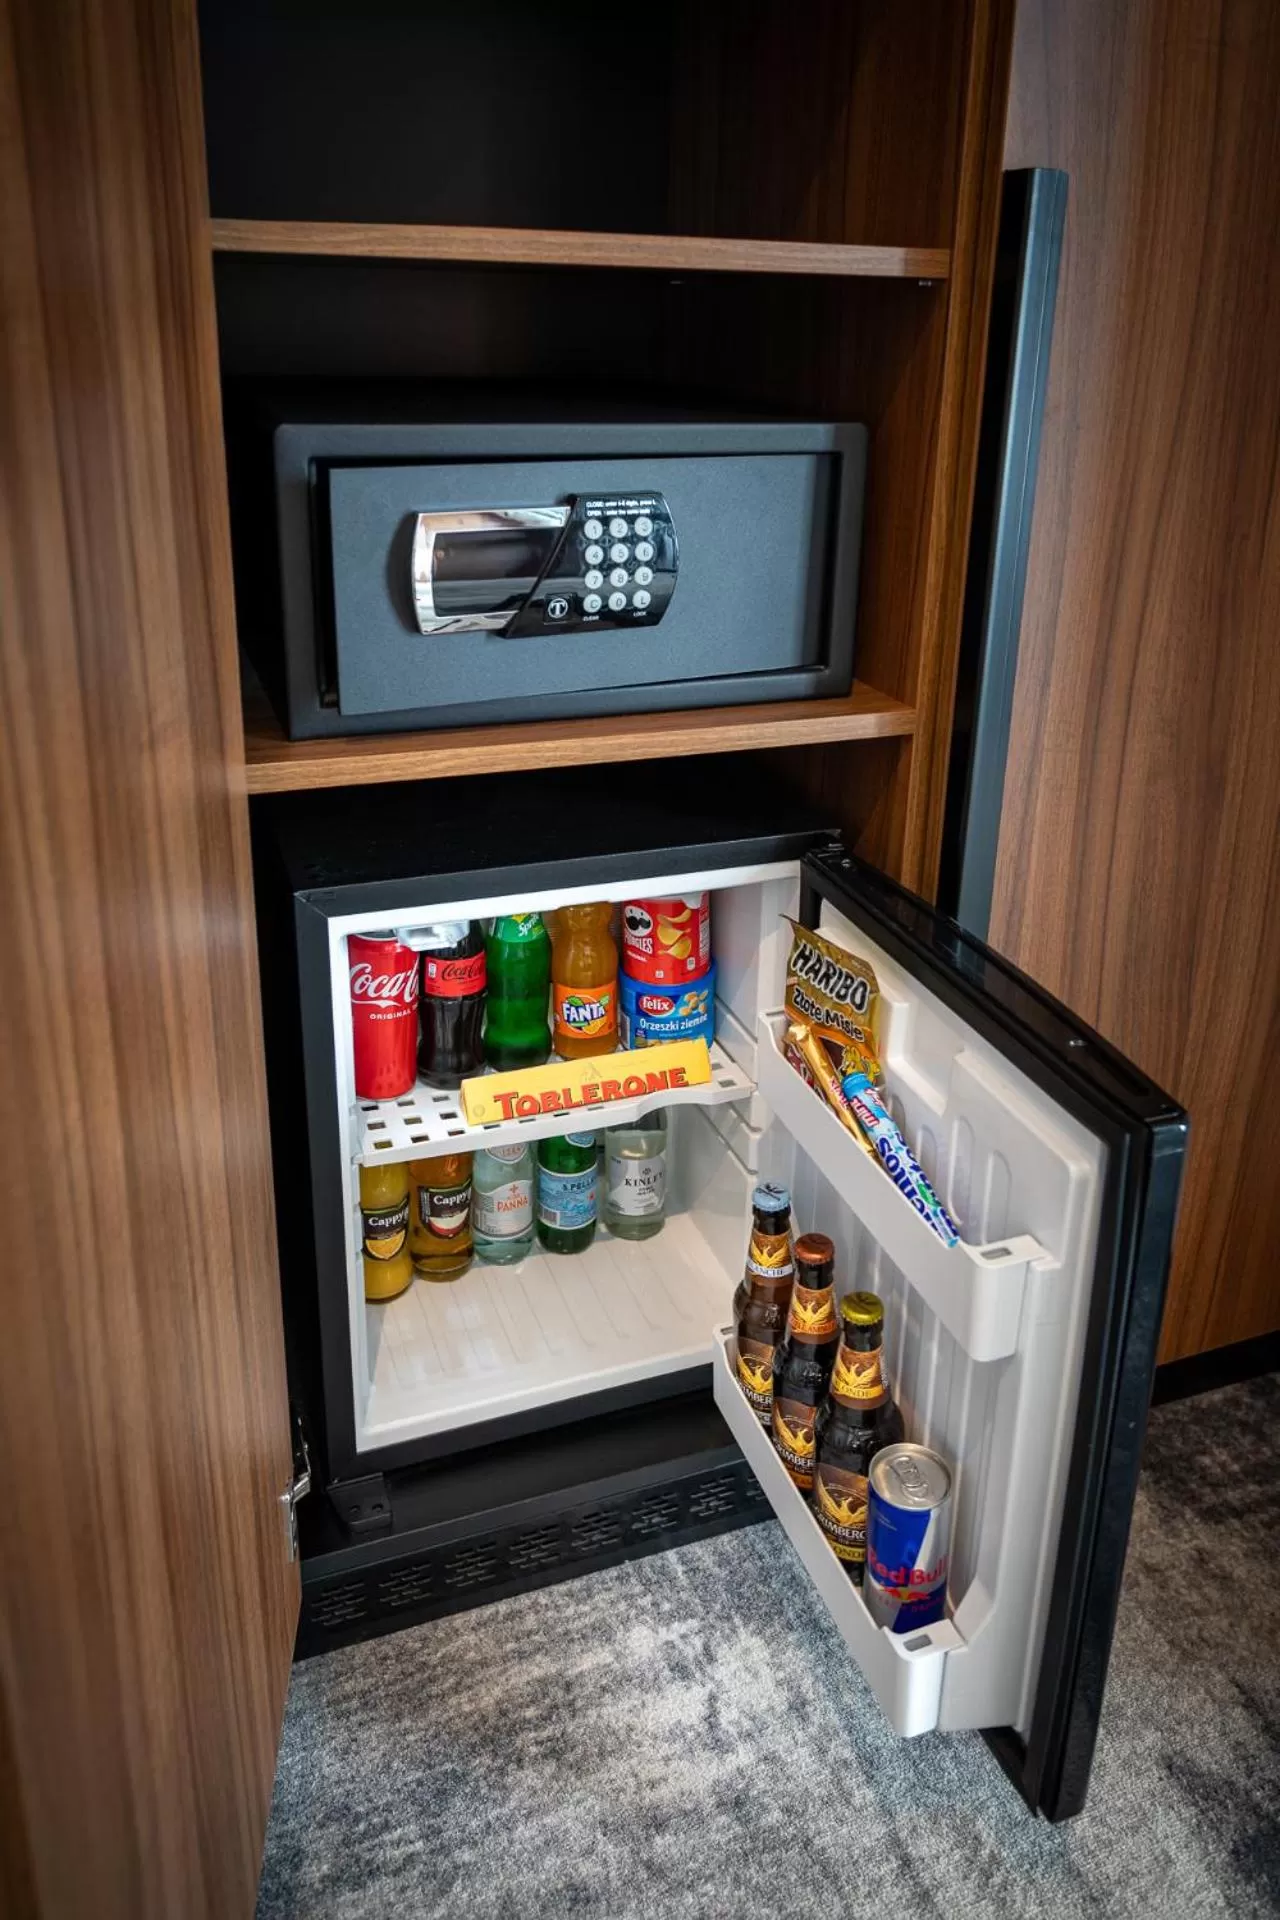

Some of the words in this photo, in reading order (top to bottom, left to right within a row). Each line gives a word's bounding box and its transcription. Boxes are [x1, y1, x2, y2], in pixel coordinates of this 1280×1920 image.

[791, 942, 870, 1013] HARIBO
[562, 1002, 606, 1022] FANTA
[643, 996, 670, 1011] felix
[369, 1009, 412, 1020] ORIGINAL
[640, 1018, 679, 1031] Orzeszki
[680, 1014, 708, 1030] ziemne
[824, 1009, 864, 1042] Misie
[493, 1067, 689, 1121] TOBLERONE
[850, 1096, 880, 1128] mint
[433, 1191, 468, 1206] Cappy
[496, 1196, 528, 1213] PANNA
[368, 1212, 404, 1227] Cappy
[868, 1544, 906, 1585] Red
[909, 1555, 948, 1585] Bull
